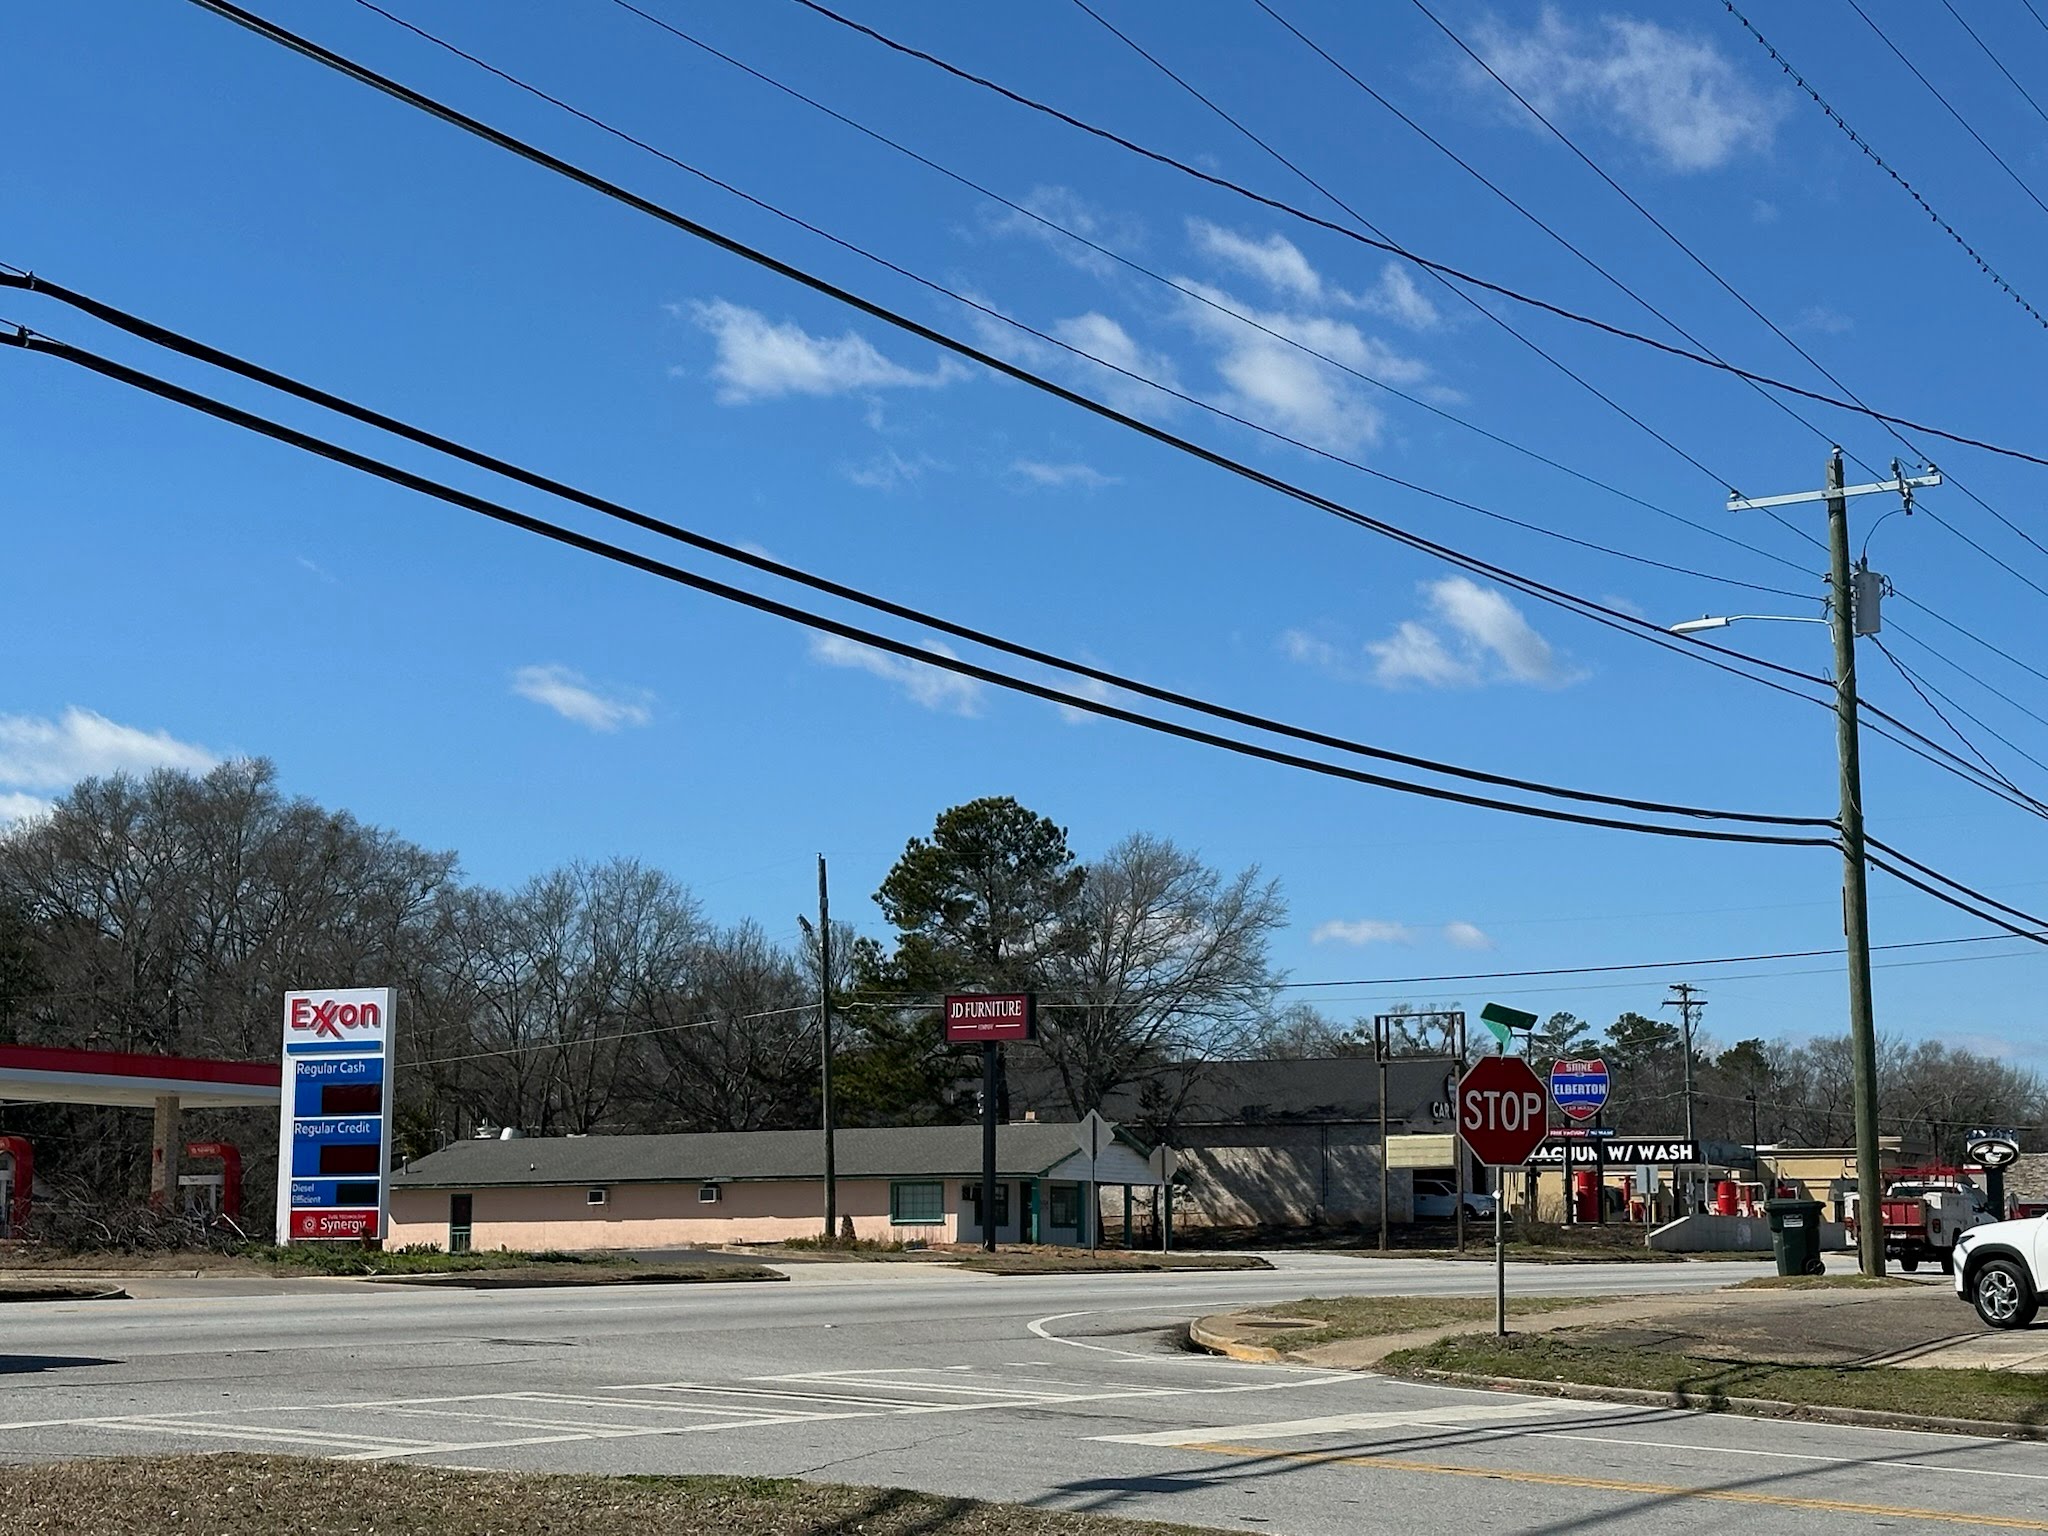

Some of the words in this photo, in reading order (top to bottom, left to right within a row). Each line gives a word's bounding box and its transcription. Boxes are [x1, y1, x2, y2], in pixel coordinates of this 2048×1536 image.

[951, 1002, 964, 1018] JD
[965, 1000, 1022, 1017] FURNITURE
[291, 998, 381, 1040] Exxon
[296, 1062, 337, 1077] Regular
[340, 1061, 365, 1073] Cash
[1566, 1063, 1593, 1072] SHINE
[1554, 1084, 1606, 1095] ELBERTON
[1433, 1101, 1451, 1118] CAR
[1464, 1089, 1542, 1131] STOP
[294, 1122, 335, 1137] Regular
[337, 1121, 370, 1133] Credit
[1607, 1144, 1633, 1161] W/
[1637, 1144, 1693, 1160] WASH
[292, 1183, 314, 1192] Diesel
[292, 1194, 321, 1204] Efficient
[320, 1217, 366, 1233] Synergy
